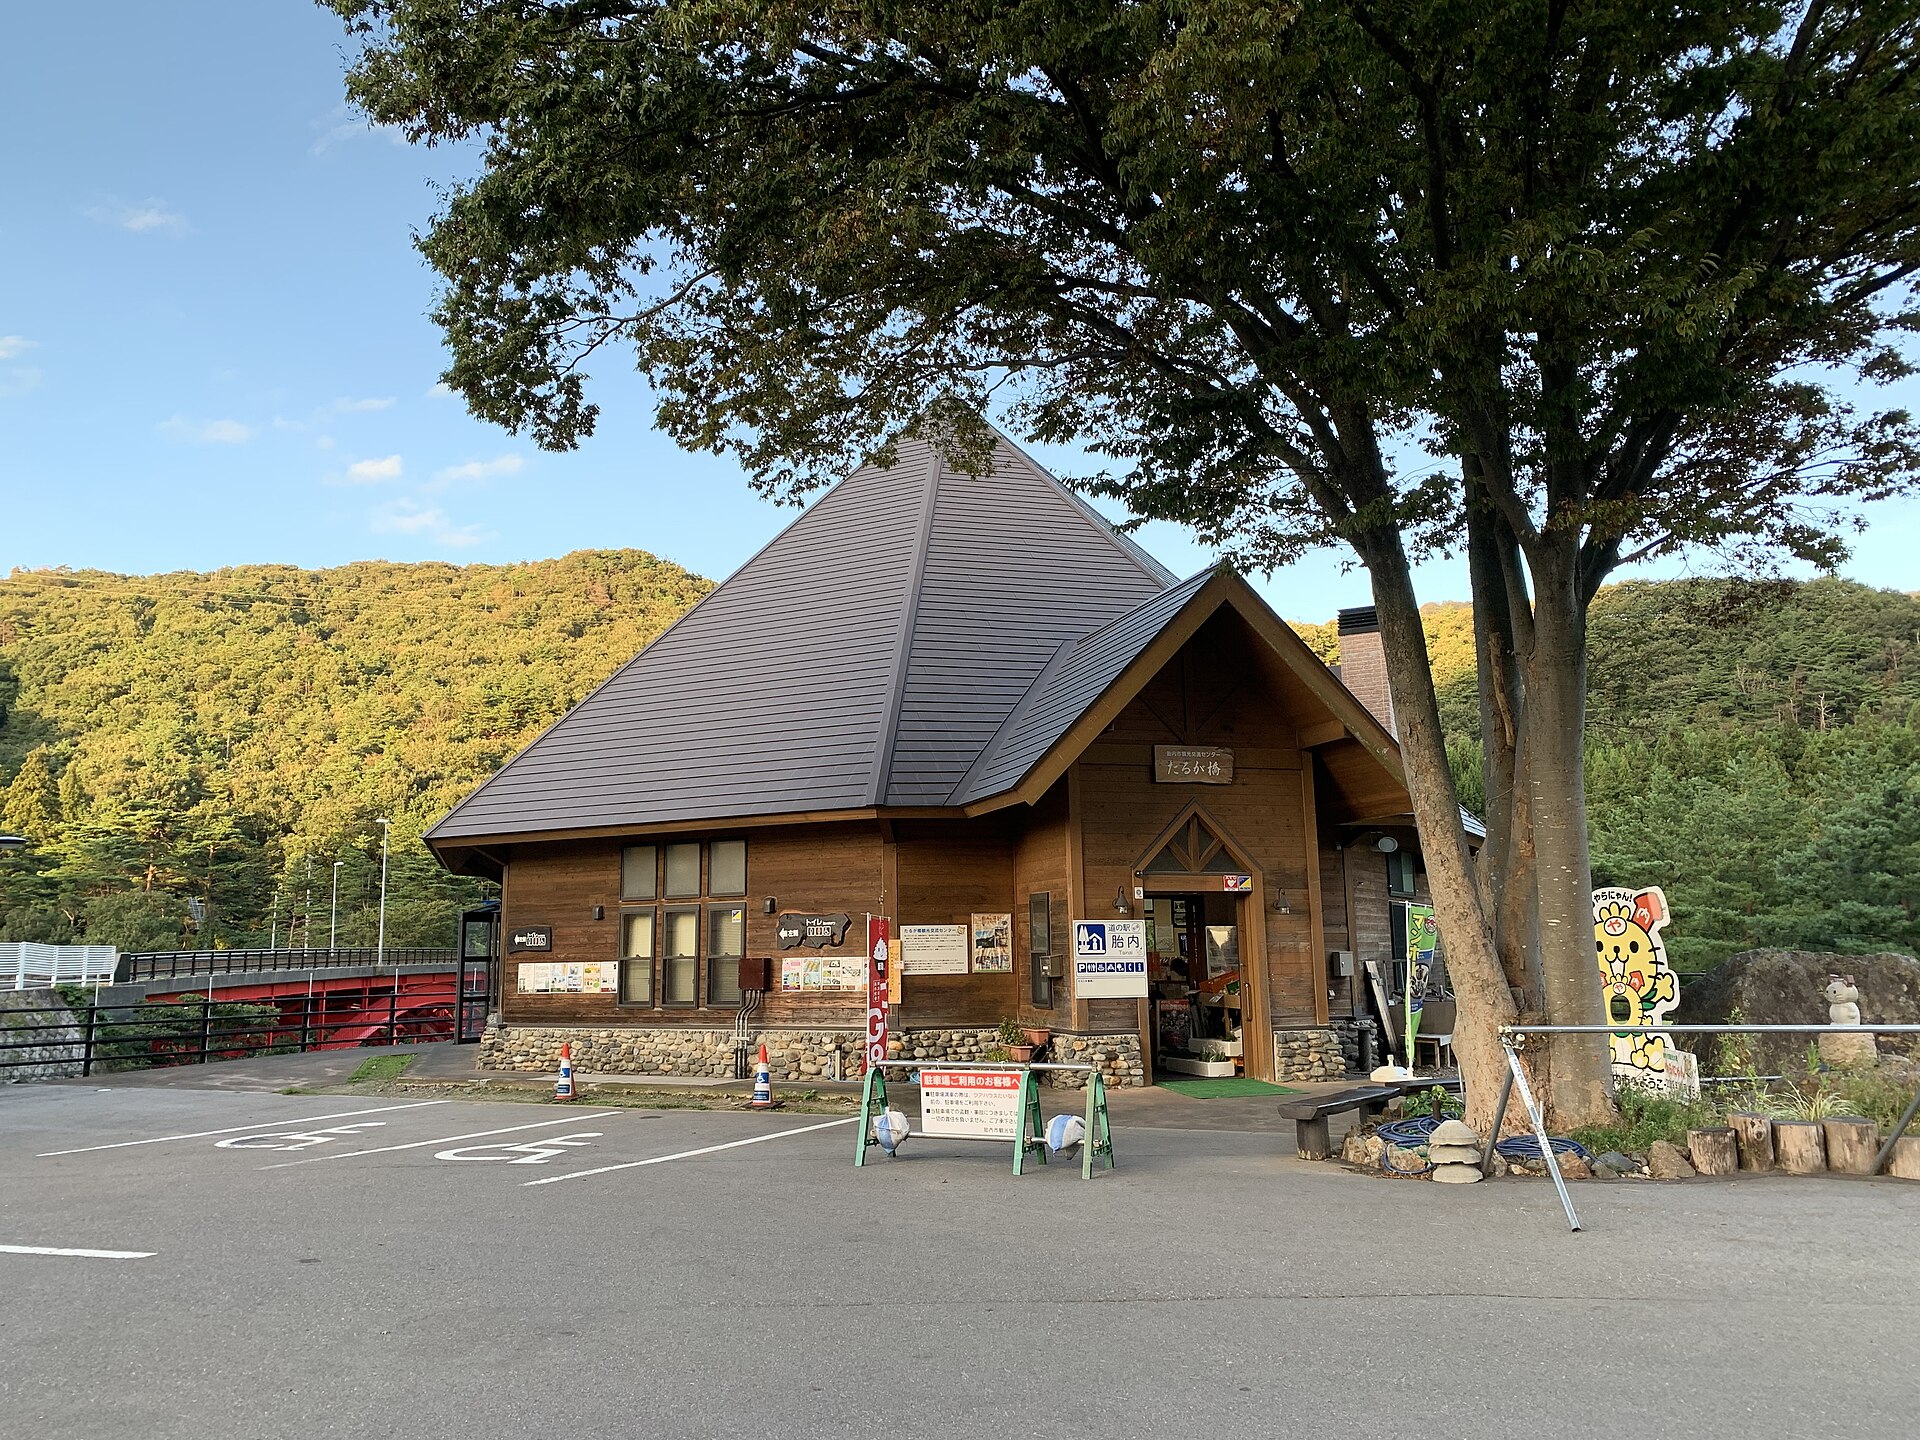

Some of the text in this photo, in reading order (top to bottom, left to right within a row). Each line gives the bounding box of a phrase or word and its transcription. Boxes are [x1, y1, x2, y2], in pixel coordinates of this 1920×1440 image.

[1167, 760, 1222, 776] たるが橋
[1593, 890, 1633, 904] やらにゃん!
[806, 918, 823, 926] トイレ
[1108, 923, 1131, 933] 道の駅
[1111, 934, 1140, 950] 胎内
[924, 1075, 1020, 1088] 駐車場ご利用のお客様へ
